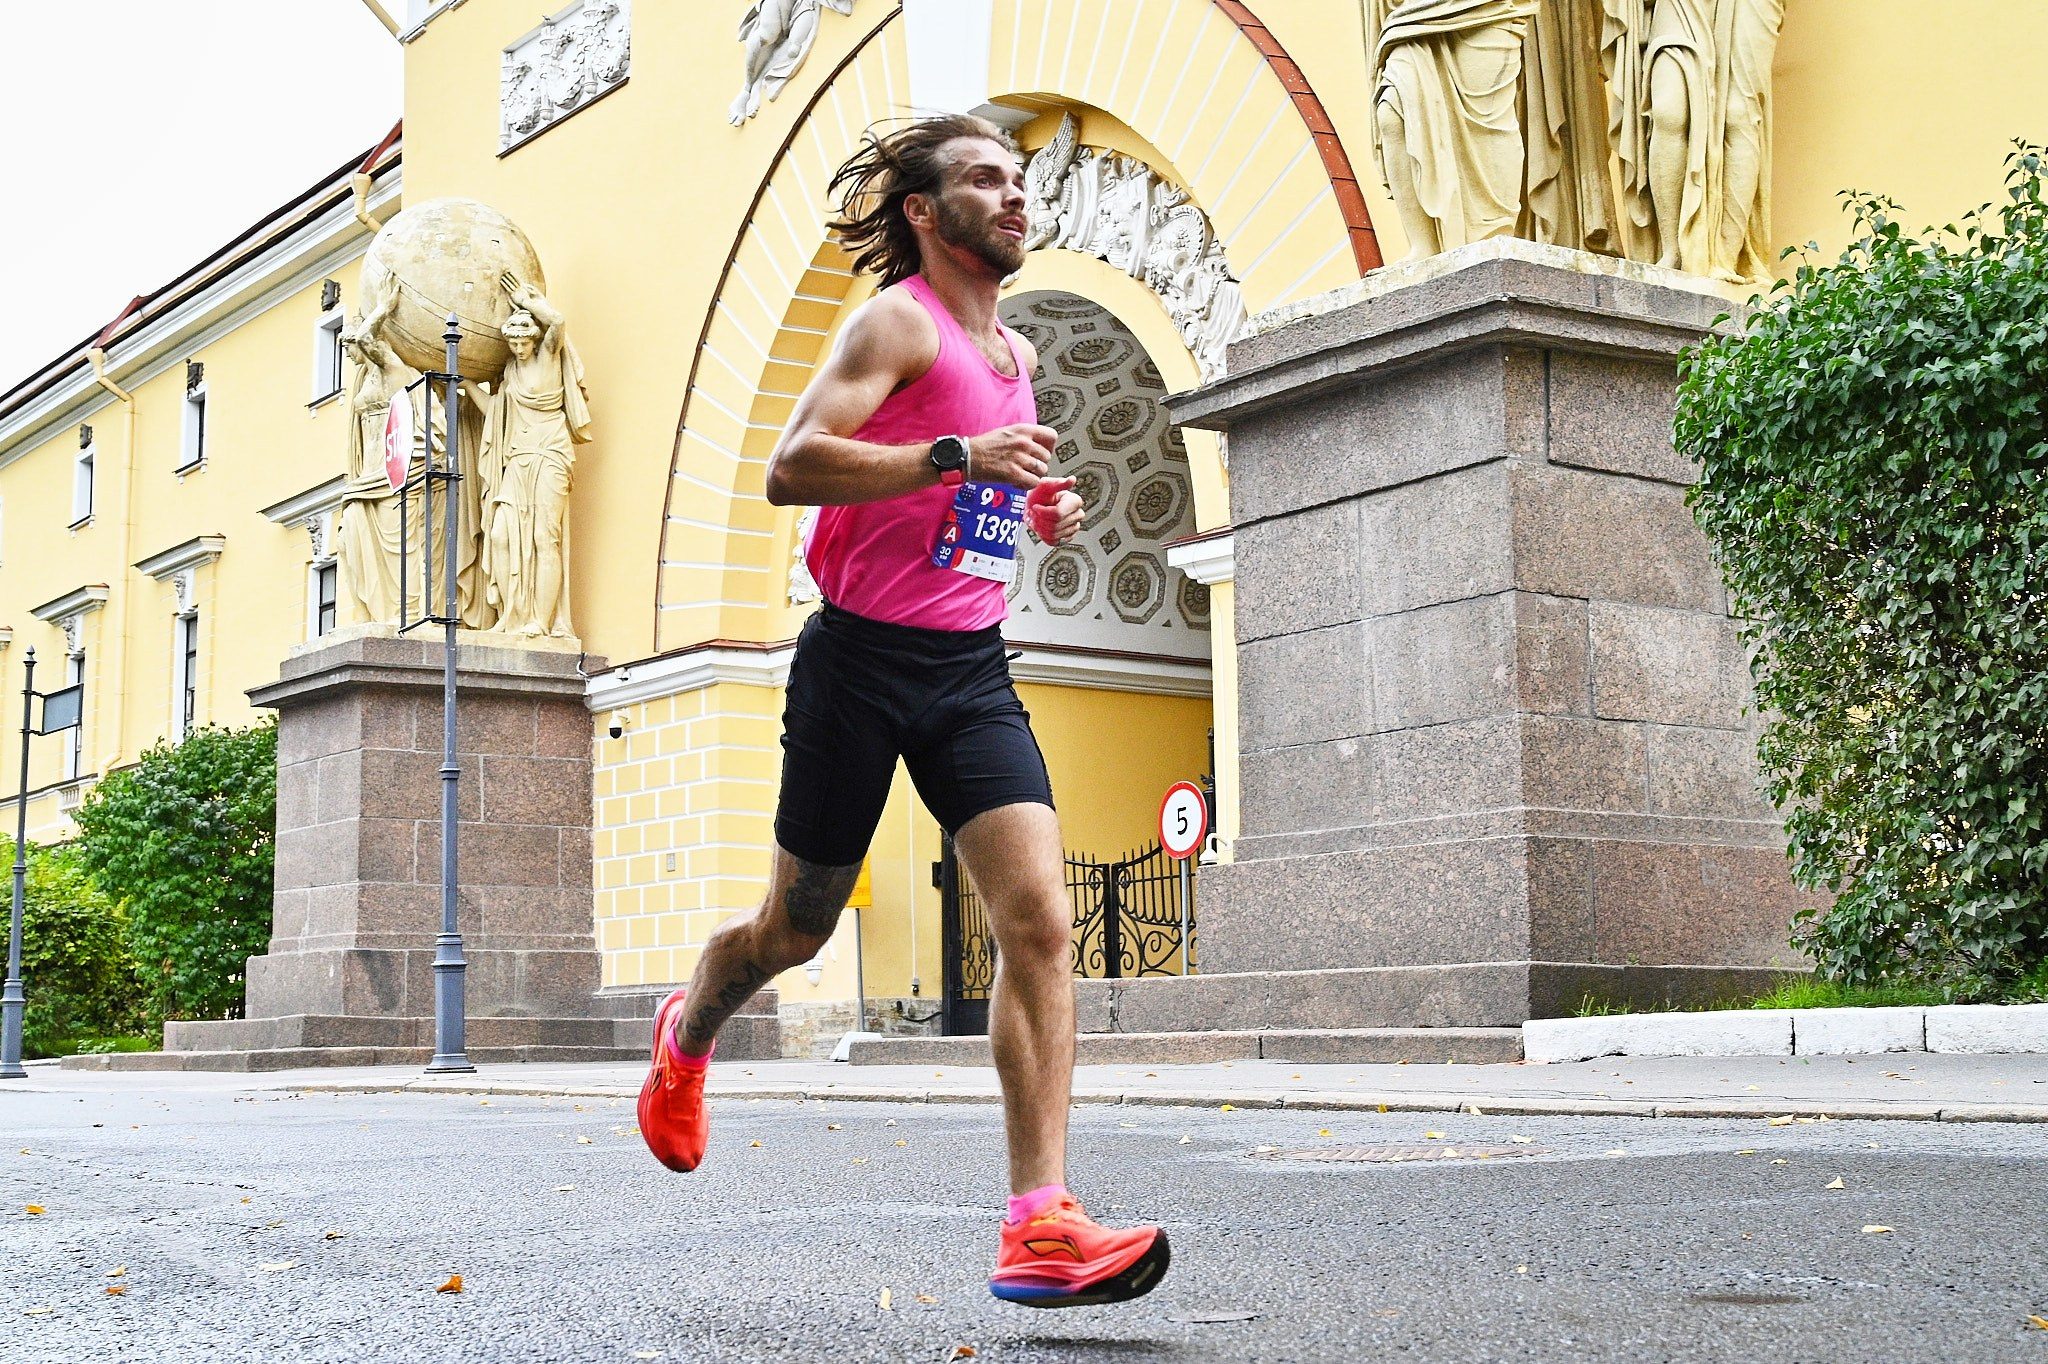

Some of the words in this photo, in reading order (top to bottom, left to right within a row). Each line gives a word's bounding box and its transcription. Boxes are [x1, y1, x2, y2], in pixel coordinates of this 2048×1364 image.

[944, 526, 957, 542] A
[939, 546, 951, 556] 30
[1177, 806, 1188, 835] 5
